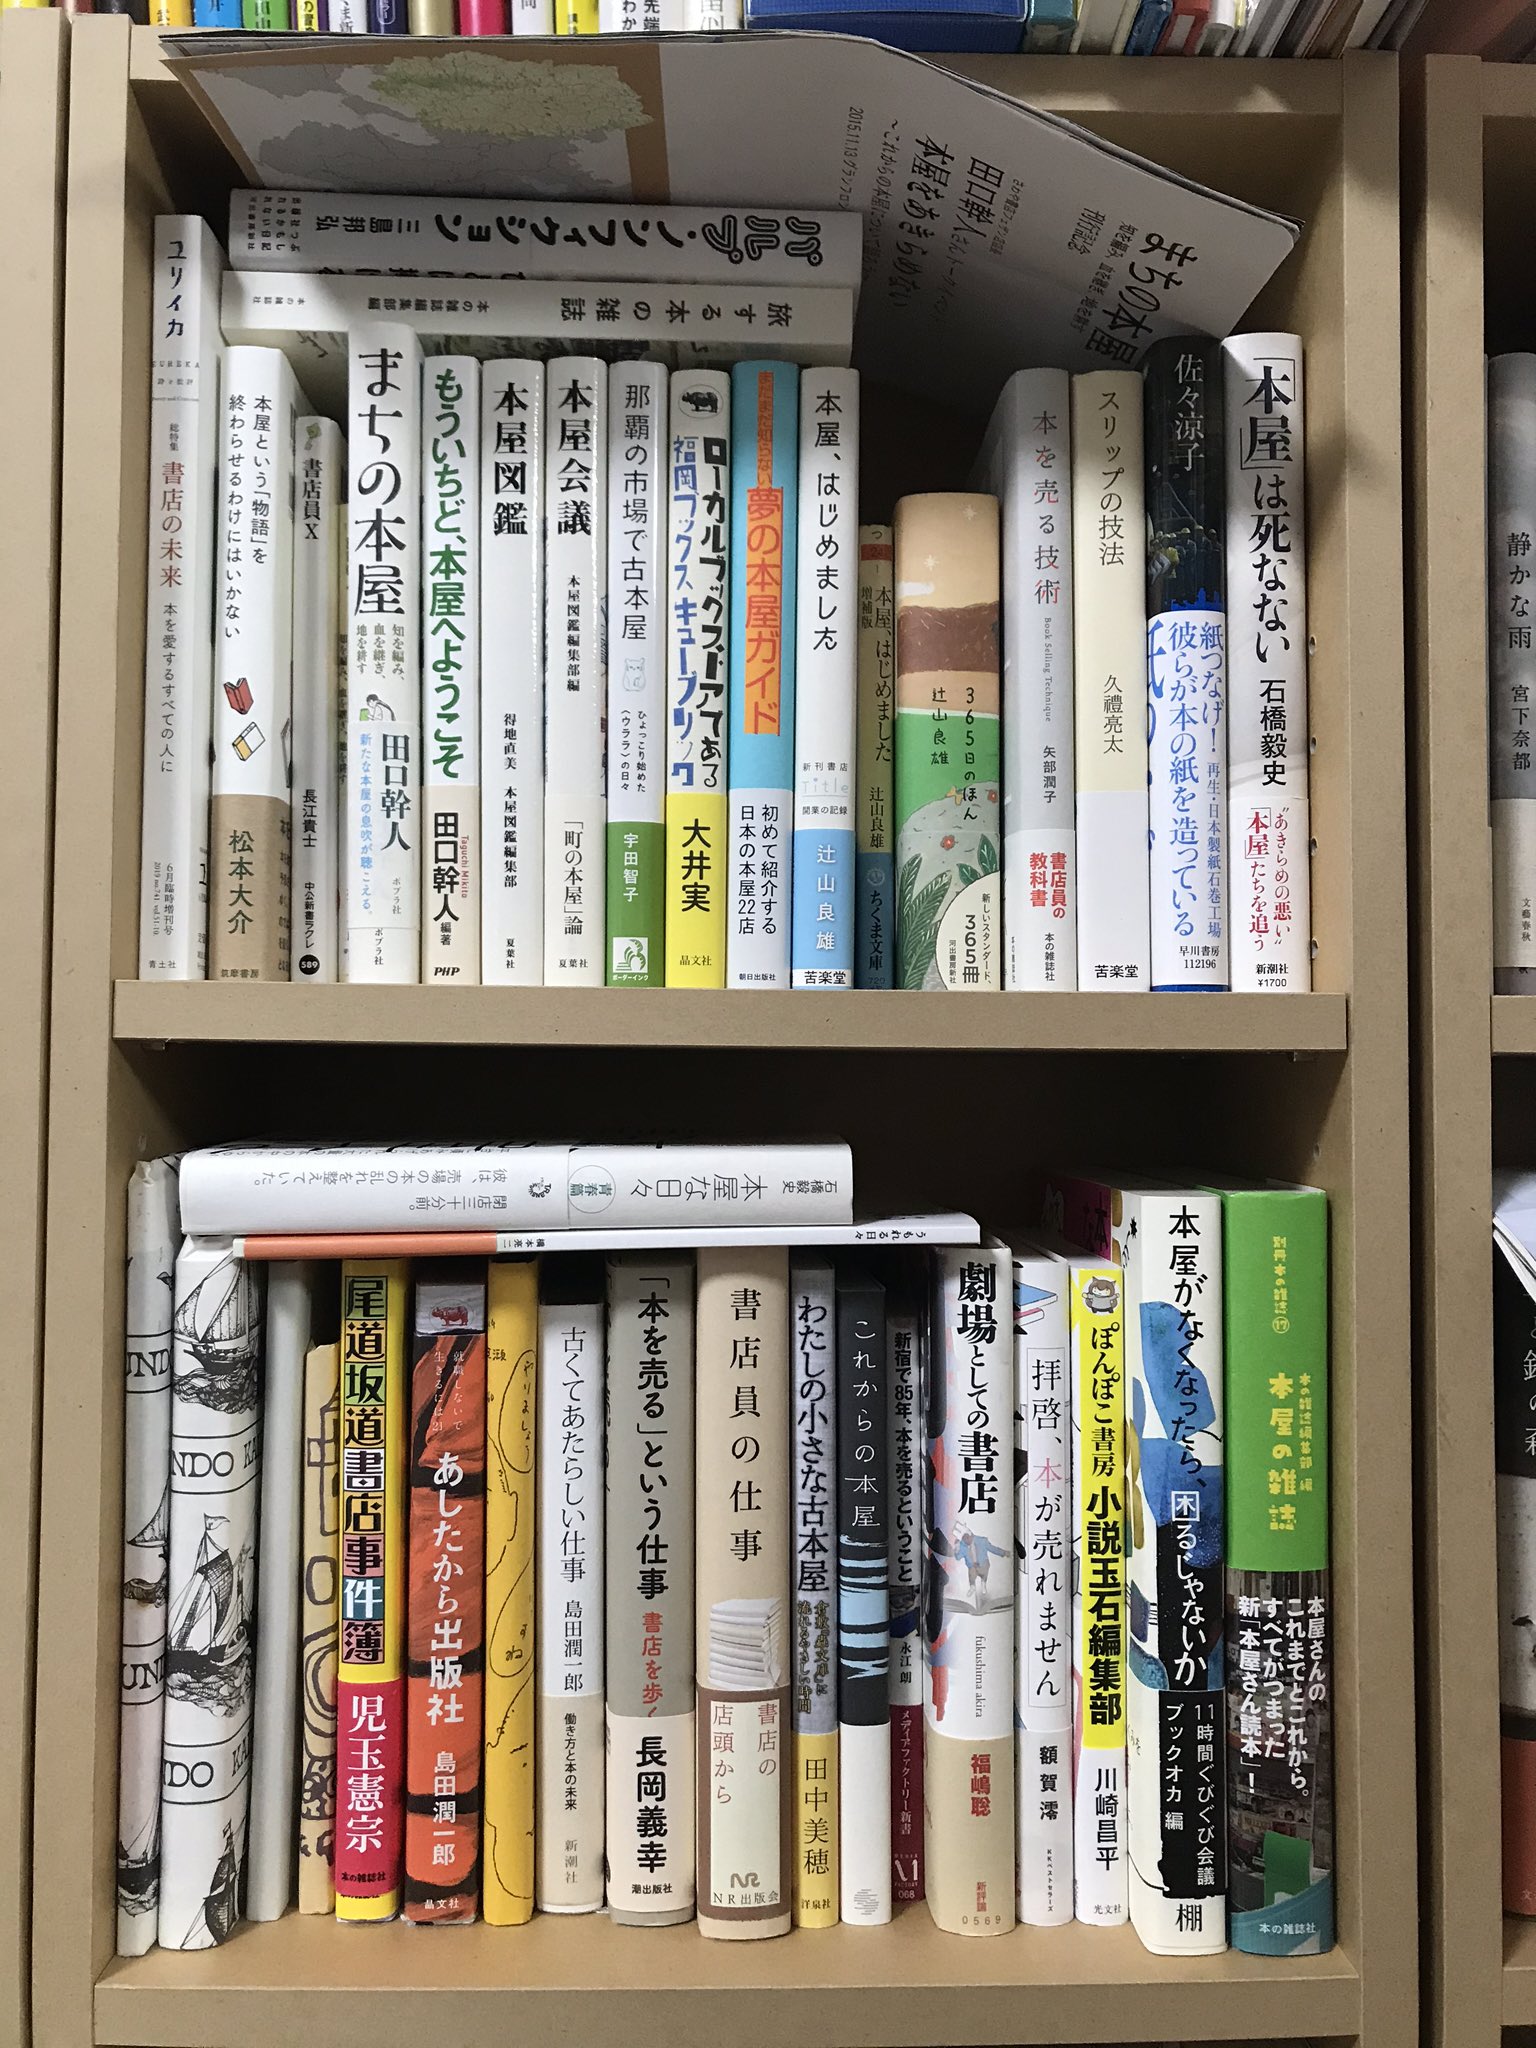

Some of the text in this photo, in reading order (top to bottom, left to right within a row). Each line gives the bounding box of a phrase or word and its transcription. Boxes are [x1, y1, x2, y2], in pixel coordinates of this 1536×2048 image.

[316, 215, 420, 234] 三島邦弘
[888, 133, 955, 307] 本屋をあきらめない
[1067, 207, 1107, 256] 刊行記念
[166, 240, 188, 339] ユリイカ
[368, 296, 490, 313] 本の雑誌編集部編
[560, 297, 793, 327] 旅する本の雑誌
[1086, 231, 1198, 366] まちの本屋
[169, 423, 180, 451] 総特集
[1174, 353, 1205, 472] 佐々涼子
[251, 394, 273, 564] 本屋という「物語」を
[302, 458, 322, 541] 書店員X
[354, 347, 407, 616] まちの本屋
[493, 382, 529, 536] 本屋図鑑
[557, 379, 592, 536] 本屋会議
[1098, 391, 1125, 567] スリップの技法
[159, 461, 185, 588] 書店の未来
[225, 394, 246, 639] 終わらせるわけにはいかない
[621, 384, 651, 640] 那覇の市場で古本屋
[813, 389, 842, 652] 本屋、はじめました
[1033, 410, 1060, 605] 本を売る技術
[1240, 357, 1296, 663] 「本屋」は死なない
[429, 369, 467, 779] もういちど、本屋へようこそ
[671, 436, 700, 787] 福岡ブックスキューブリック
[744, 488, 783, 735] 夢の本屋ガイド
[861, 586, 873, 630] 増補版
[1507, 531, 1532, 650] 静かな雨
[356, 625, 367, 674] 地を耕す
[373, 623, 386, 679] 血を継ぎ、
[392, 624, 405, 680] 知を編み、
[567, 575, 581, 692] 本屋図鑑編集部編
[875, 586, 893, 763] 本屋、はじめました
[1043, 617, 1052, 722] Book Selling Technique
[159, 603, 178, 773] 本を愛するすべての人に
[931, 686, 950, 766] 辻山良雄
[1103, 674, 1124, 754] 久禮亮太
[1512, 684, 1531, 771] 宮下奈都
[637, 709, 647, 793] ひょっこり始めた
[802, 762, 849, 772] 新刊書店
[963, 687, 978, 822] 365日のほん
[1043, 745, 1057, 804] 矢部潤子
[1260, 679, 1287, 786] 石橋毅史
[302, 788, 318, 848] 長江貴士
[380, 733, 412, 852] 田口幹人
[503, 713, 518, 888] 得地直美 本屋図鑑編集部
[802, 777, 849, 794] Title
[802, 806, 848, 815] 開業の記録
[868, 786, 885, 849] 辻山良雄
[1168, 621, 1200, 937] 彼らが本の紙を造っている
[1200, 622, 1224, 938] 紙つなげ！ 再生・日本製紙石巻工場
[228, 829, 255, 934] 松本大介
[433, 812, 460, 923] 田口幹人
[461, 835, 469, 899] Taguchi Mikito
[563, 819, 584, 936] 「町の本屋」論
[623, 832, 639, 903] 宇田智子
[681, 819, 711, 912] 大井実
[738, 805, 756, 934] 日本の本屋22店
[761, 804, 779, 934] 初めて紹介する
[816, 844, 836, 952] 辻山良雄
[1030, 852, 1048, 907] 教科書
[1050, 851, 1067, 919] 書店員の
[1244, 807, 1272, 951] 「本屋」たちを追う
[304, 881, 315, 949] 中公新書ラクレ
[374, 928, 384, 966] ポプラ社
[440, 922, 452, 946] 編著
[505, 938, 516, 969] 夏葉社
[868, 890, 883, 971] ちくま文庫
[962, 914, 980, 984] 365冊
[1044, 932, 1055, 981] 本の雑誌社
[1179, 945, 1220, 957] 早川書房
[221, 968, 260, 979] 筑摩書房
[301, 960, 319, 970] 589
[434, 966, 461, 977] PHP
[558, 957, 588, 969] 夏葉社
[679, 955, 712, 966] 晶文社
[738, 973, 776, 981] 朝日出版社
[804, 971, 846, 985] 苦楽堂
[1094, 965, 1139, 979] 苦楽堂
[1184, 958, 1217, 969] 112196
[1256, 963, 1288, 975] 新潮社
[1257, 978, 1288, 987] ¥1700
[253, 1168, 508, 1187] 彼は、売場の本の乱れを整えていた。
[408, 1195, 508, 1211] 閉店三十分前。
[630, 1173, 768, 1202] 本屋な日々
[781, 1179, 838, 1194] 石橋毅史
[855, 1230, 926, 1240] うもれる日々
[453, 1350, 464, 1431] 就職しないで
[729, 1287, 762, 1562] 書店員の仕事
[844, 1320, 880, 1527] これからの本屋
[957, 1262, 999, 1515] 劇場としての書店
[343, 1276, 388, 1664] 尾道坂道書店事件簿
[636, 1277, 670, 1600] 「本を売る」という仕事
[797, 1296, 829, 1592] わたしの小さな古本屋
[894, 1332, 913, 1583] 新宿で85年、本を売るということ
[1168, 1205, 1208, 1687] 本屋がなくなったら、困るじゃないか
[1268, 1372, 1298, 1531] 本屋の雑誌
[560, 1327, 586, 1692] 古くてあたらしい仕事 島田潤一郎
[1031, 1359, 1063, 1697] 拝啓、本が売れません
[1086, 1321, 1122, 1726] ぽんぽこ書房 小説玉石編集部
[426, 1452, 465, 1866] あしたから出版社 島田潤一郎
[899, 1641, 912, 1684] 永江朗
[975, 1635, 984, 1718] fukushima akira
[1264, 1597, 1287, 1758] すべてがつまった
[1307, 1596, 1326, 1700] 本屋さんの
[1238, 1596, 1262, 1793] 新「本屋さん読本」！
[1286, 1598, 1309, 1798] これまでとこれから。
[346, 1695, 387, 1853] 児玉憲宗
[564, 1713, 577, 1811] 働き方と本の未来
[713, 1705, 734, 1805] 店頭から
[757, 1702, 778, 1777] 書店の
[1165, 1703, 1184, 1831] ブックオカ 編
[636, 1736, 668, 1873] 長岡義幸
[803, 1758, 830, 1875] 田中美穂
[1040, 1746, 1058, 1821] 額賀澪
[1095, 1767, 1119, 1871] 川崎昌平
[1195, 1704, 1215, 1887] 11時間ぐびぐび会議
[341, 1871, 386, 1883] 本の雑誌社
[424, 1898, 459, 1910] 晶文社
[565, 1839, 578, 1884] 新潮社
[631, 1883, 673, 1895] 潮出版社
[713, 1891, 779, 1905] NR出版会
[801, 1898, 831, 1910] 洋泉社
[898, 1890, 915, 1899] 068
[962, 1915, 1002, 1926] 0569
[1094, 1904, 1121, 1915] 光文社
[1175, 1903, 1202, 1933] 棚
[1259, 1923, 1317, 1934] 本の雑誌社
